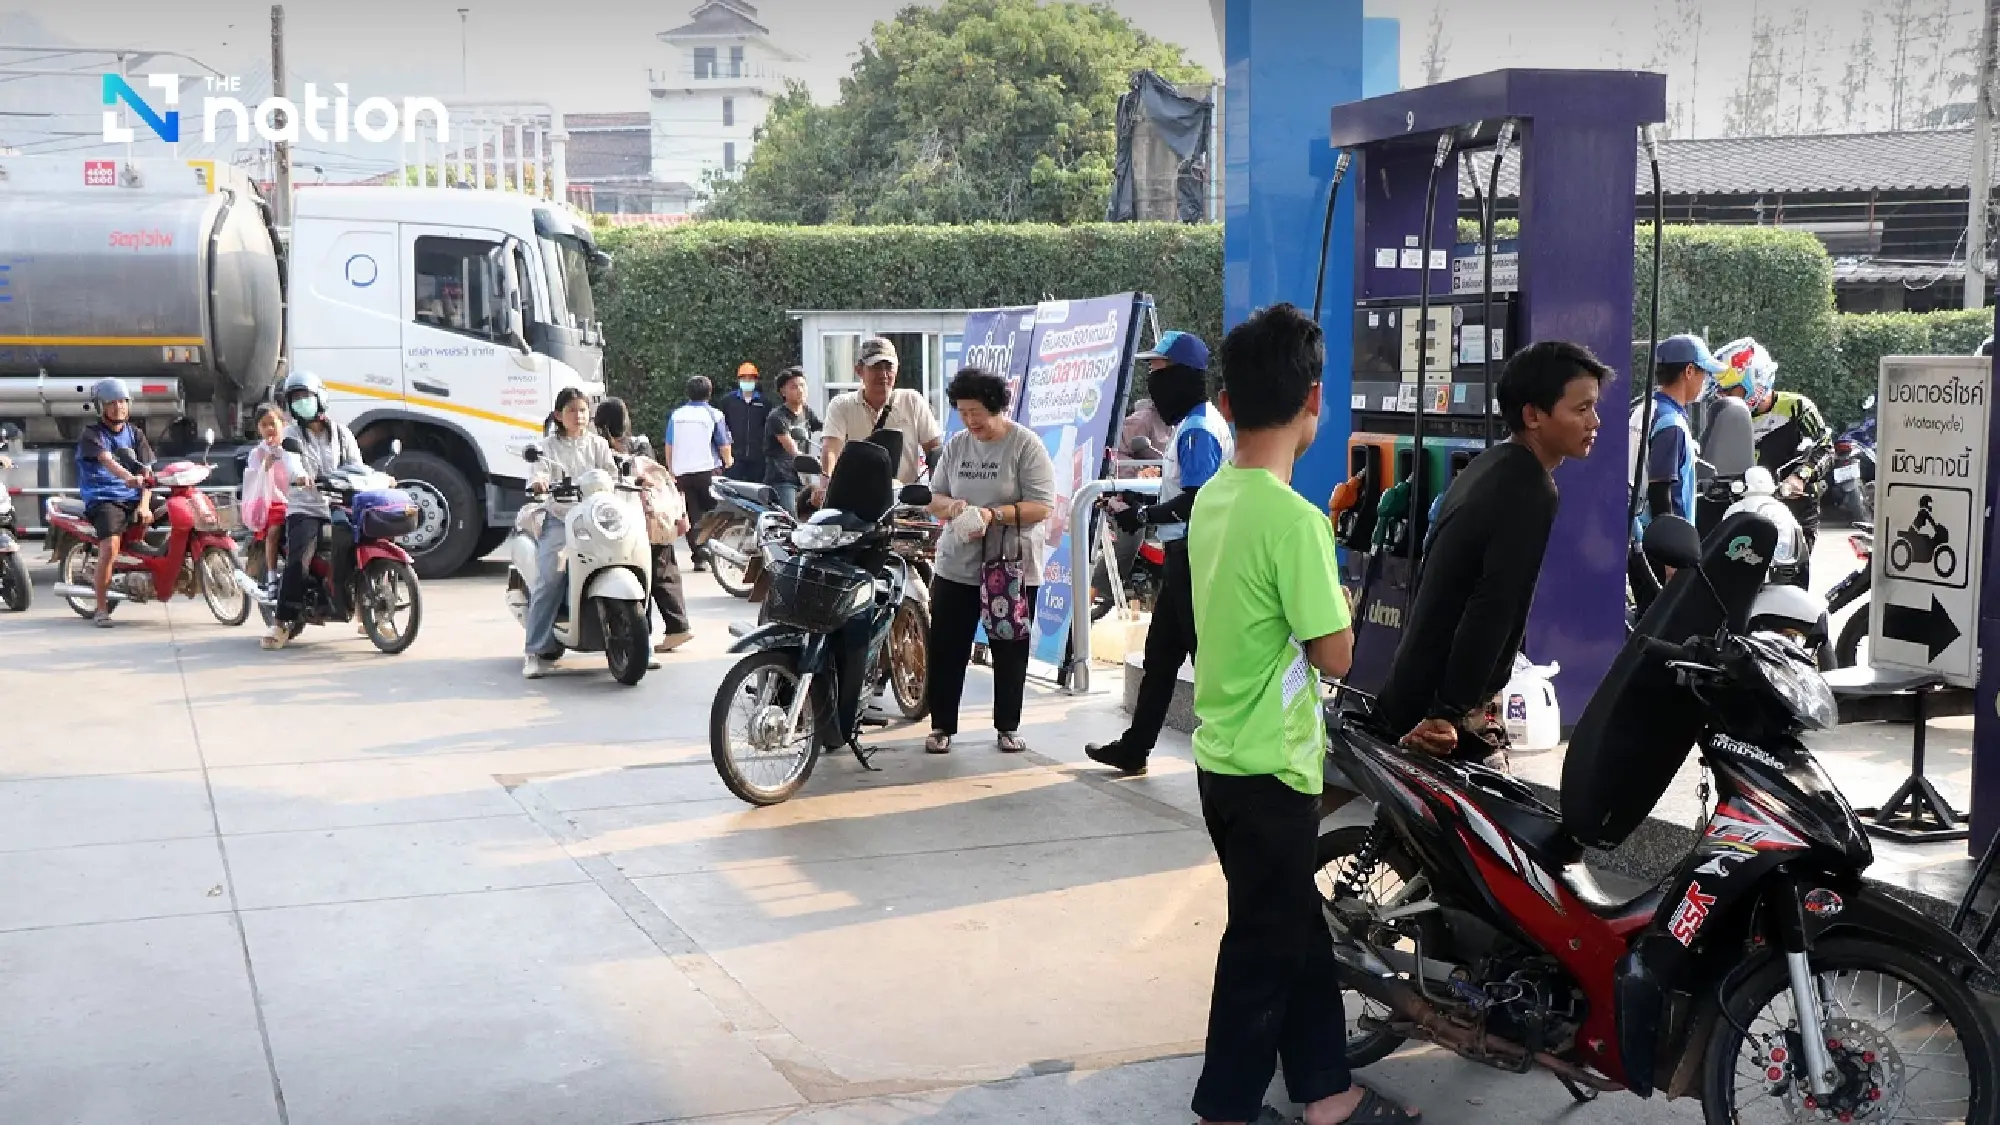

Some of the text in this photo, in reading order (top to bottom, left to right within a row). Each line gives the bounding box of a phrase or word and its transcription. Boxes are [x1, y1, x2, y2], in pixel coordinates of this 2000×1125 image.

[1405, 110, 1415, 132] 9
[108, 228, 173, 252] วัตถุไวไฟ
[1903, 414, 1964, 435] (Motorcycle)
[1891, 446, 1973, 478] เชิญทางนี้
[1671, 880, 1717, 948] SSK
